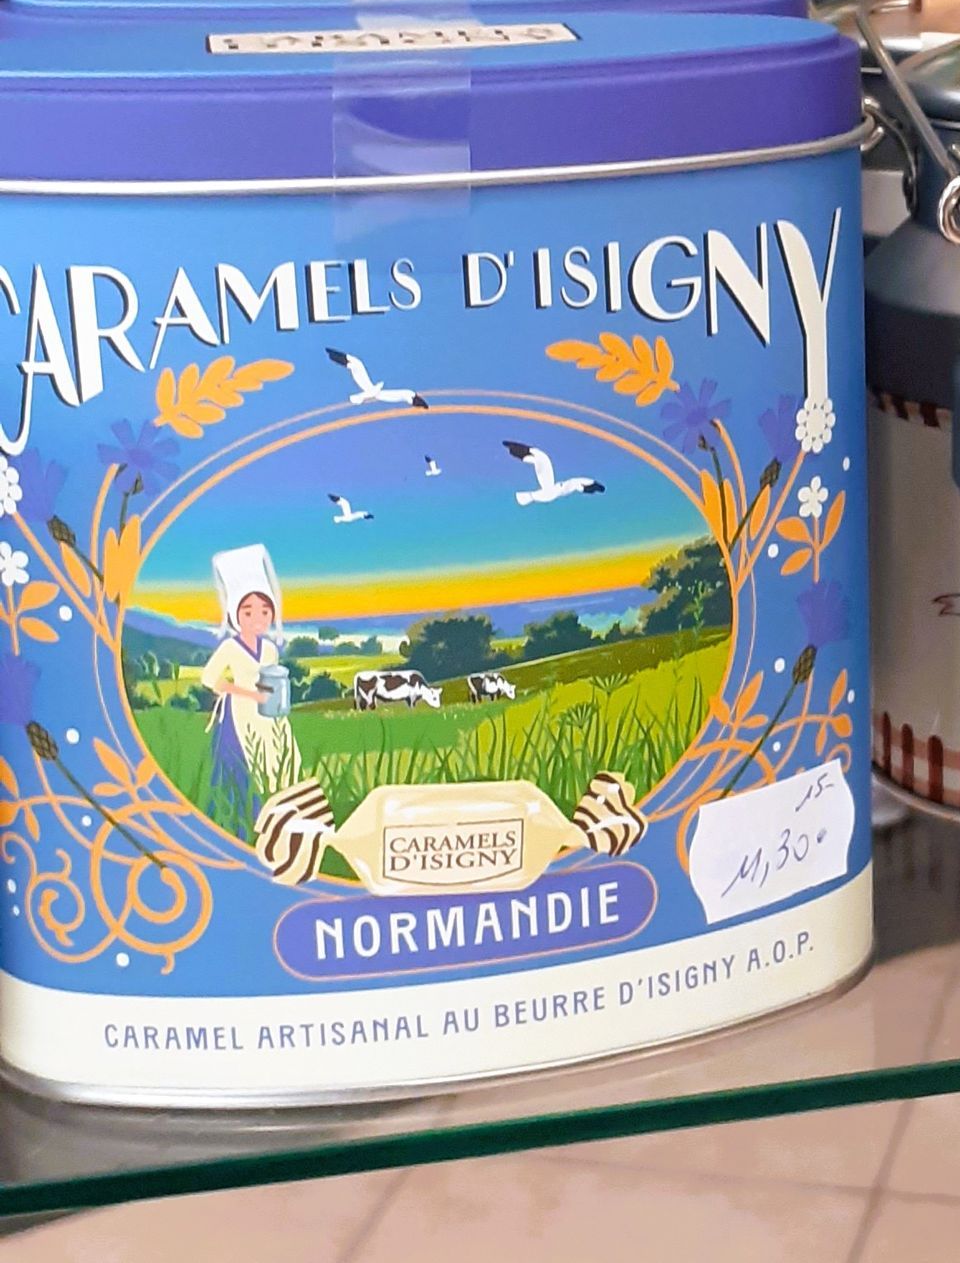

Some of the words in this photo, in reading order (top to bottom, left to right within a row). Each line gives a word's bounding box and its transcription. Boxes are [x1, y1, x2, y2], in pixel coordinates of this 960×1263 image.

[465, 207, 842, 404] D'ISIGNY
[389, 830, 518, 857] CARAMELS
[389, 847, 520, 873] D'ISIGNY
[314, 882, 621, 962] NORMANDIE
[103, 1021, 245, 1051] CARAMEL
[257, 1015, 430, 1050] ARTISANAL
[441, 1007, 481, 1035] AU
[494, 987, 606, 1028] BEURRE
[618, 955, 735, 1007] D'ISIGNY
[747, 933, 815, 974] A.O.P.
